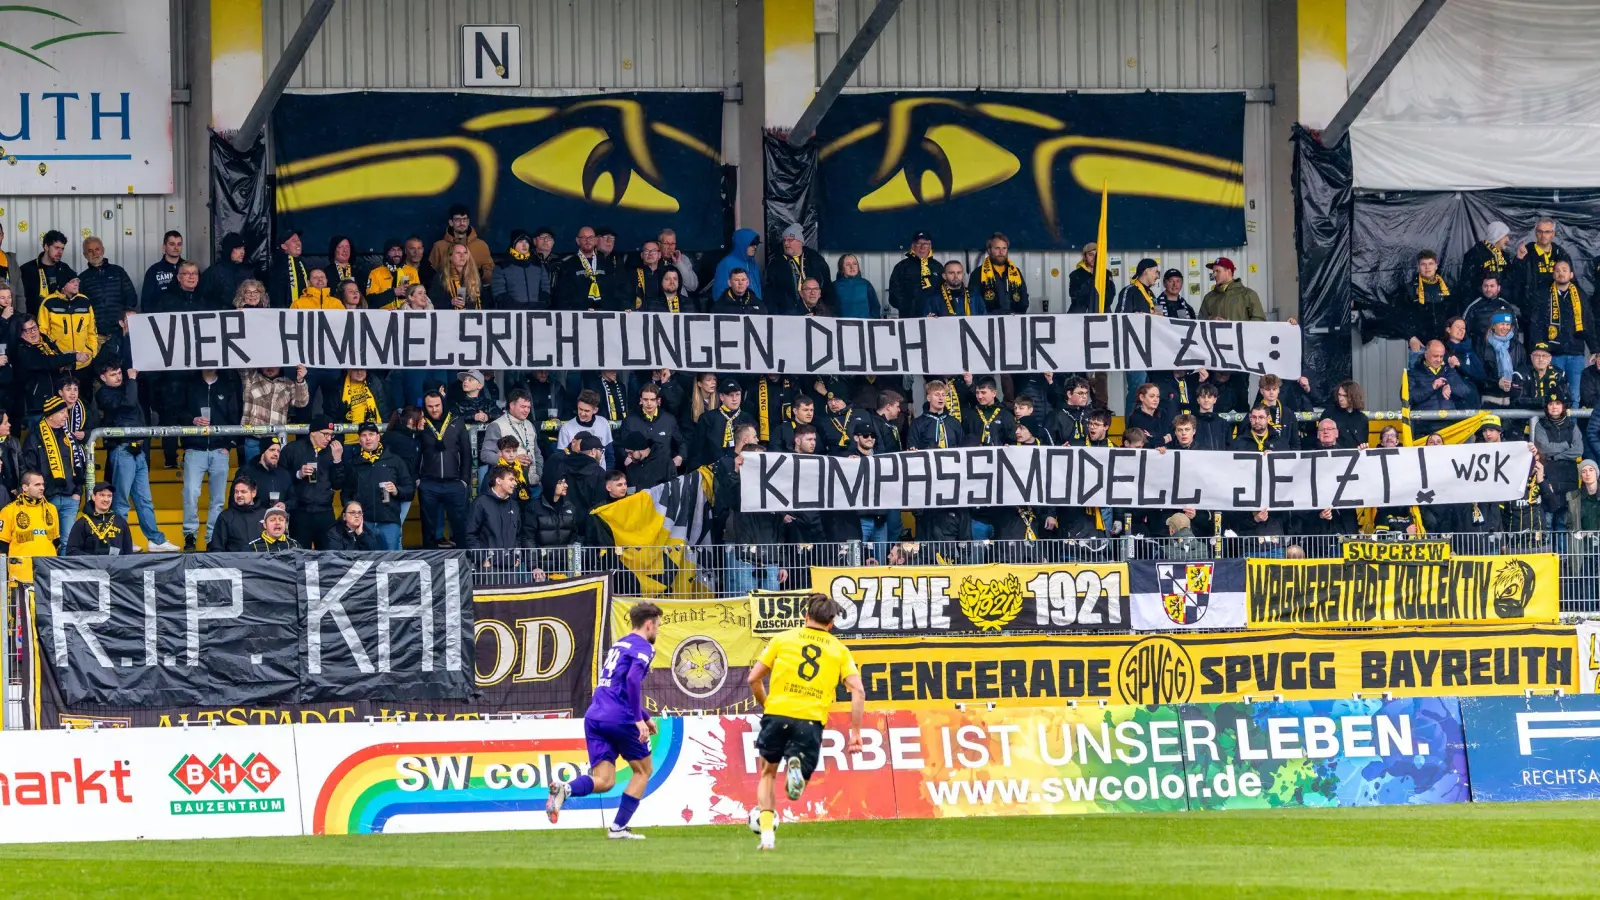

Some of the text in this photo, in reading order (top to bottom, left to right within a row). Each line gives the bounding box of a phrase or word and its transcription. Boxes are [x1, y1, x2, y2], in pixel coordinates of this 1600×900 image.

[475, 31, 509, 79] N
[148, 309, 1281, 376] VIER HIMMELSRICHTUNGEN, DOCH NUR EIN ZIEL:
[760, 447, 1511, 510] KOMPASSMODELL JETZT! WSK
[1348, 543, 1445, 561] SUPCREW
[759, 597, 810, 619] USK
[830, 570, 1122, 630] SZENE 1921
[1248, 560, 1493, 623] WAGNERSTADT KOLLEKTIV
[50, 558, 462, 674] R.I.P. KAI
[756, 619, 806, 628] ABSCHAFF
[798, 643, 822, 682] 8
[1125, 644, 1187, 705] SPVGG
[1200, 652, 1336, 695] SPVGG
[1360, 647, 1573, 690] BAYREUTH
[742, 714, 1430, 774] FRBE IST UNSER LEBEN.
[186, 762, 271, 785] BHG
[395, 755, 473, 792] SW
[926, 764, 1262, 806] www.swcolor.de
[173, 800, 282, 813] BAUZENTRUM
